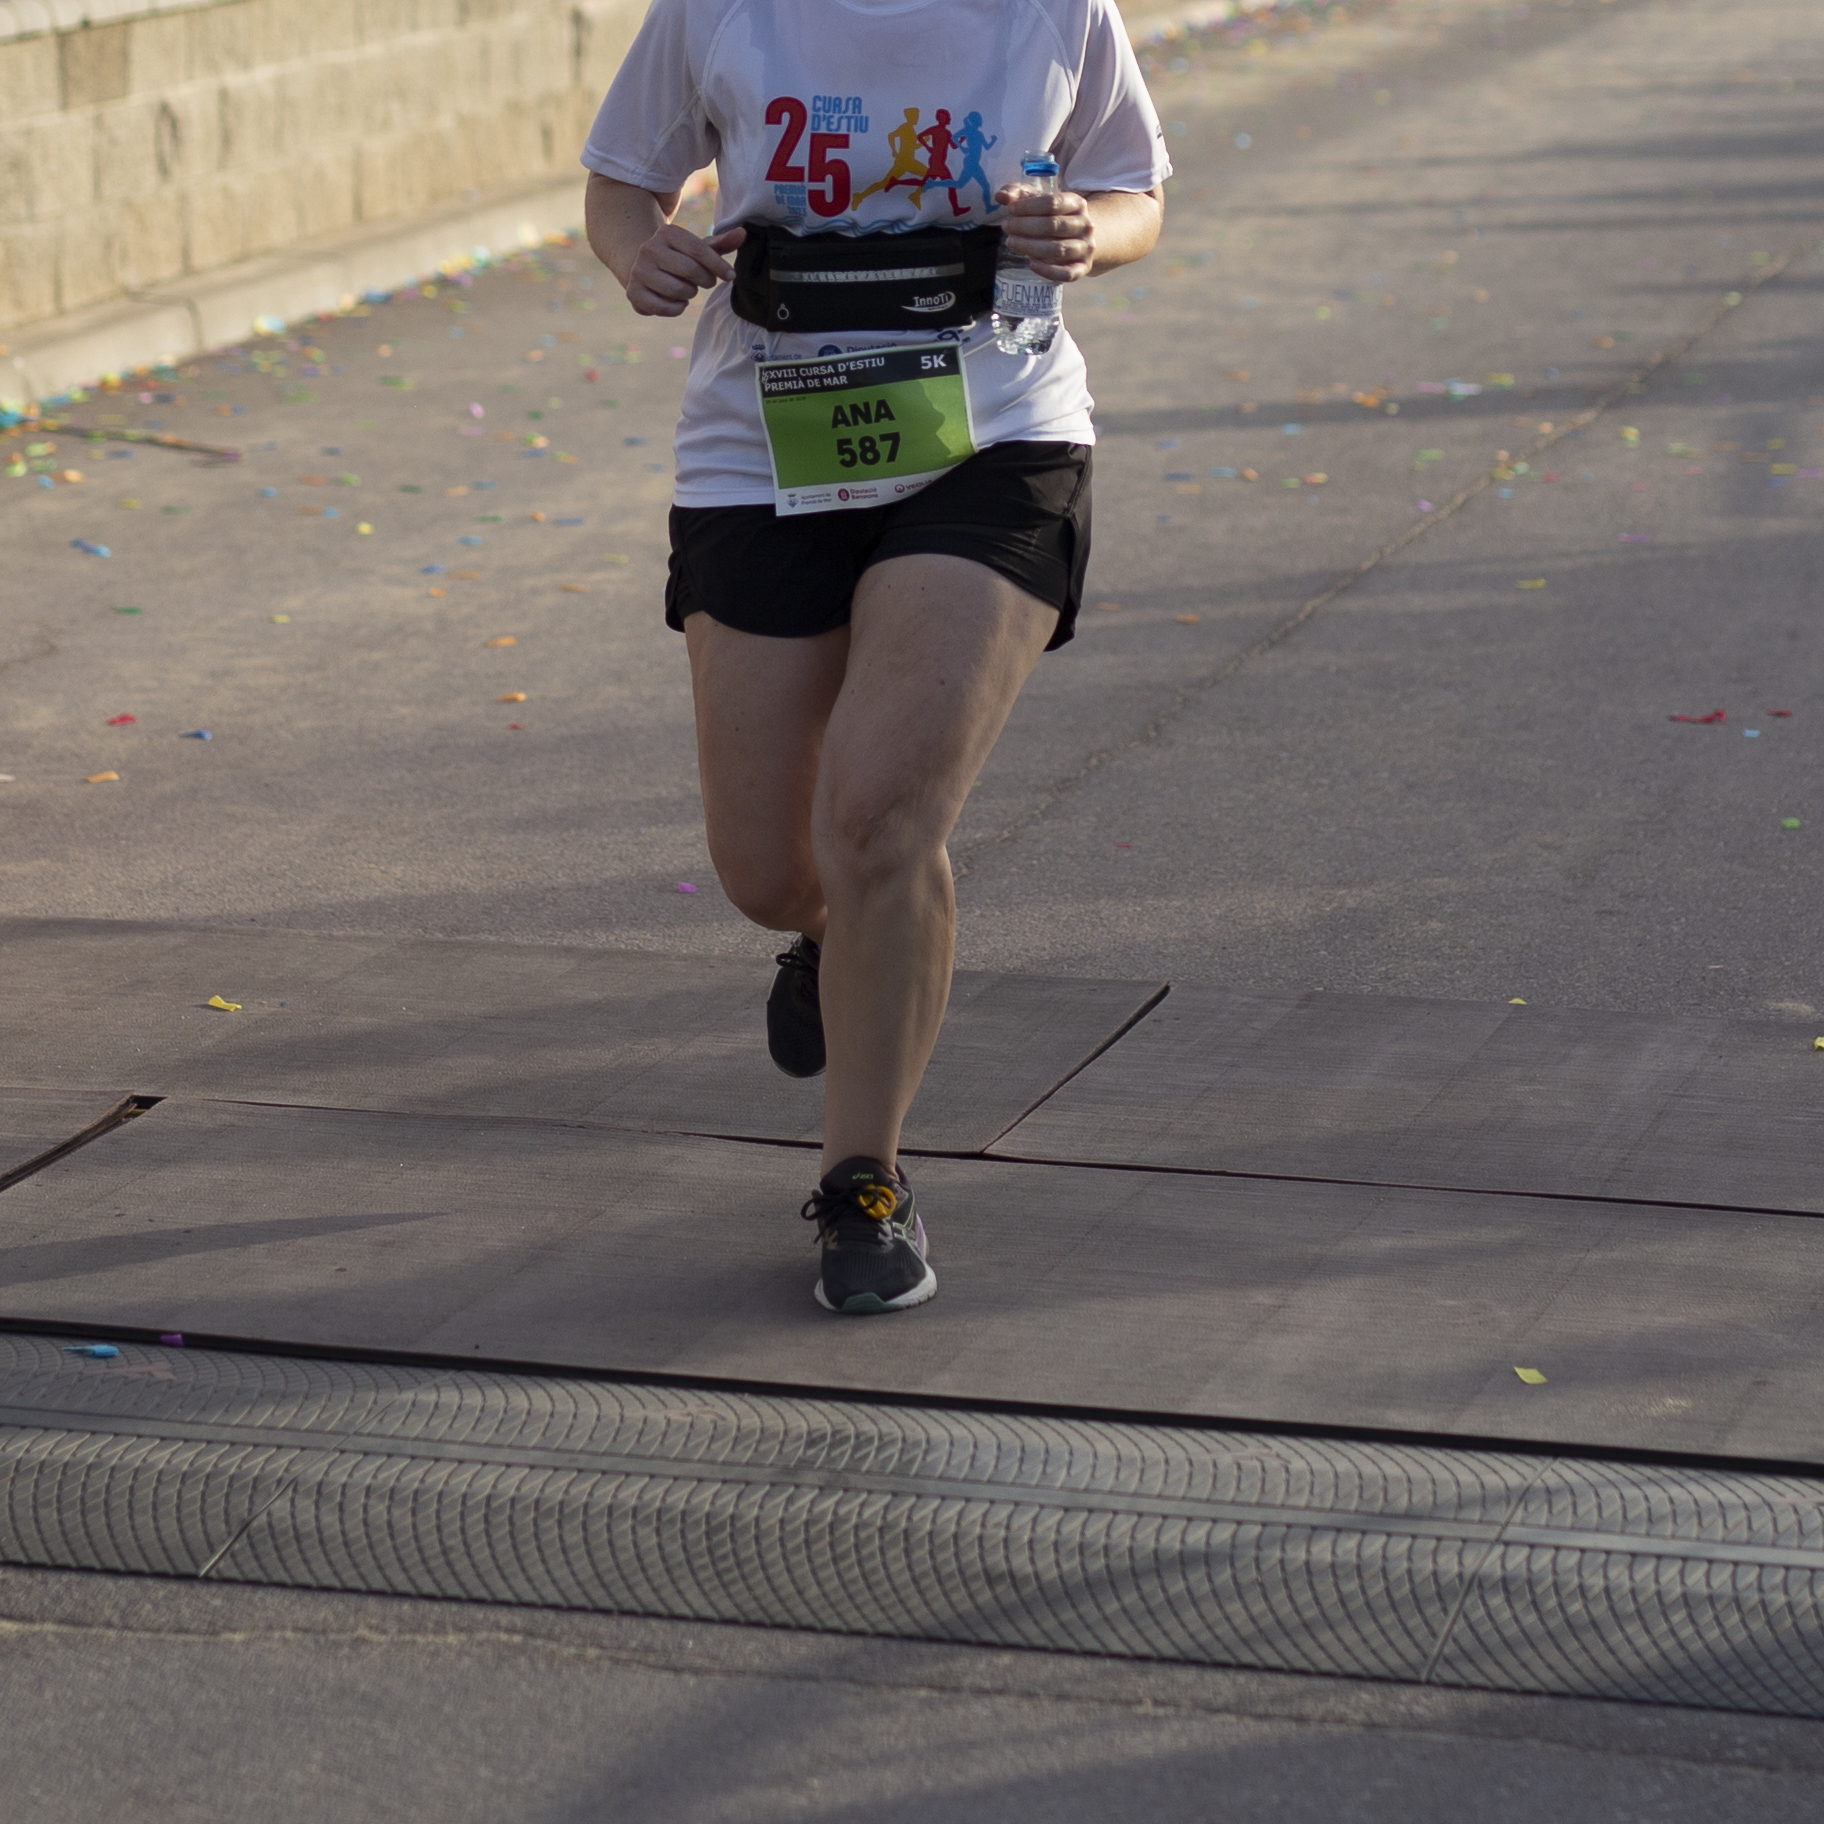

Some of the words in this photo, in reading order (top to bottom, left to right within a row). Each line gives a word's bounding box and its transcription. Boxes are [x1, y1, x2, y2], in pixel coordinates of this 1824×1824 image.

[811, 94, 863, 115] CURSA
[764, 95, 852, 219] 25
[799, 364, 836, 378] CURSA
[838, 357, 885, 372] D'ESTIU
[920, 354, 947, 370] 5K
[764, 377, 806, 393] PREMIÀ
[807, 378, 823, 389] DE
[823, 375, 850, 387] MAR
[831, 399, 896, 428] ANA
[836, 431, 901, 468] 587
